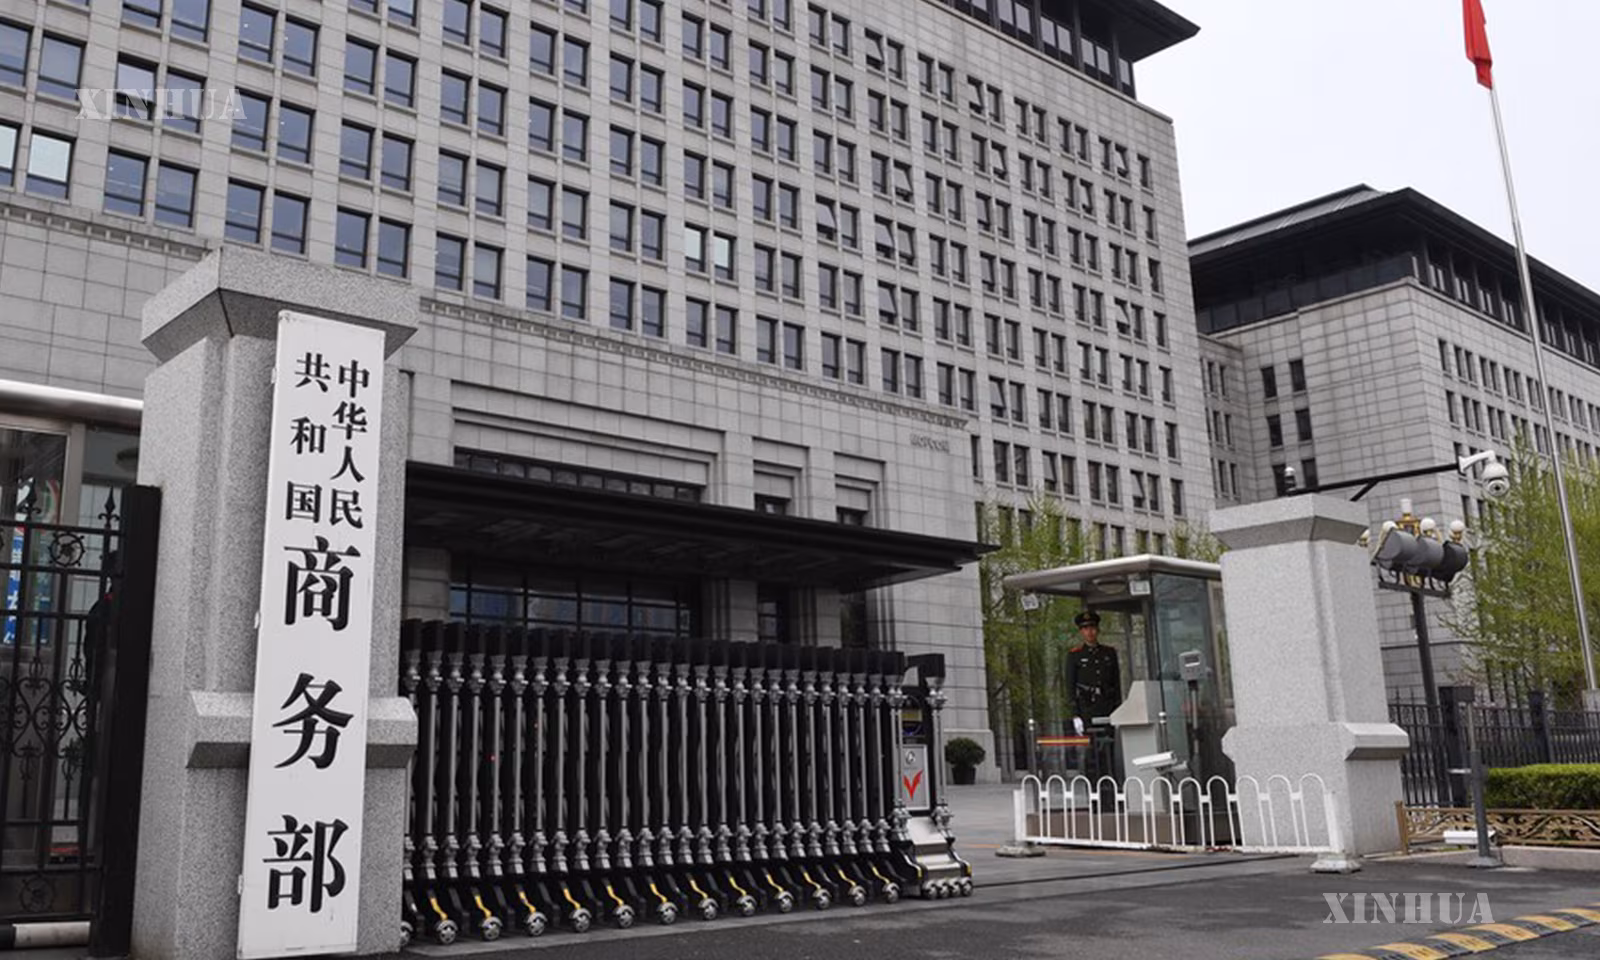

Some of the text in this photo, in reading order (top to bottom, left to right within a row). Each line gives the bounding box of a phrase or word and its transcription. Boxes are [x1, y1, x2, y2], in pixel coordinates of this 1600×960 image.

[285, 351, 332, 524] 共和国
[330, 359, 370, 529] 中华人民
[262, 535, 362, 914] 商务部
